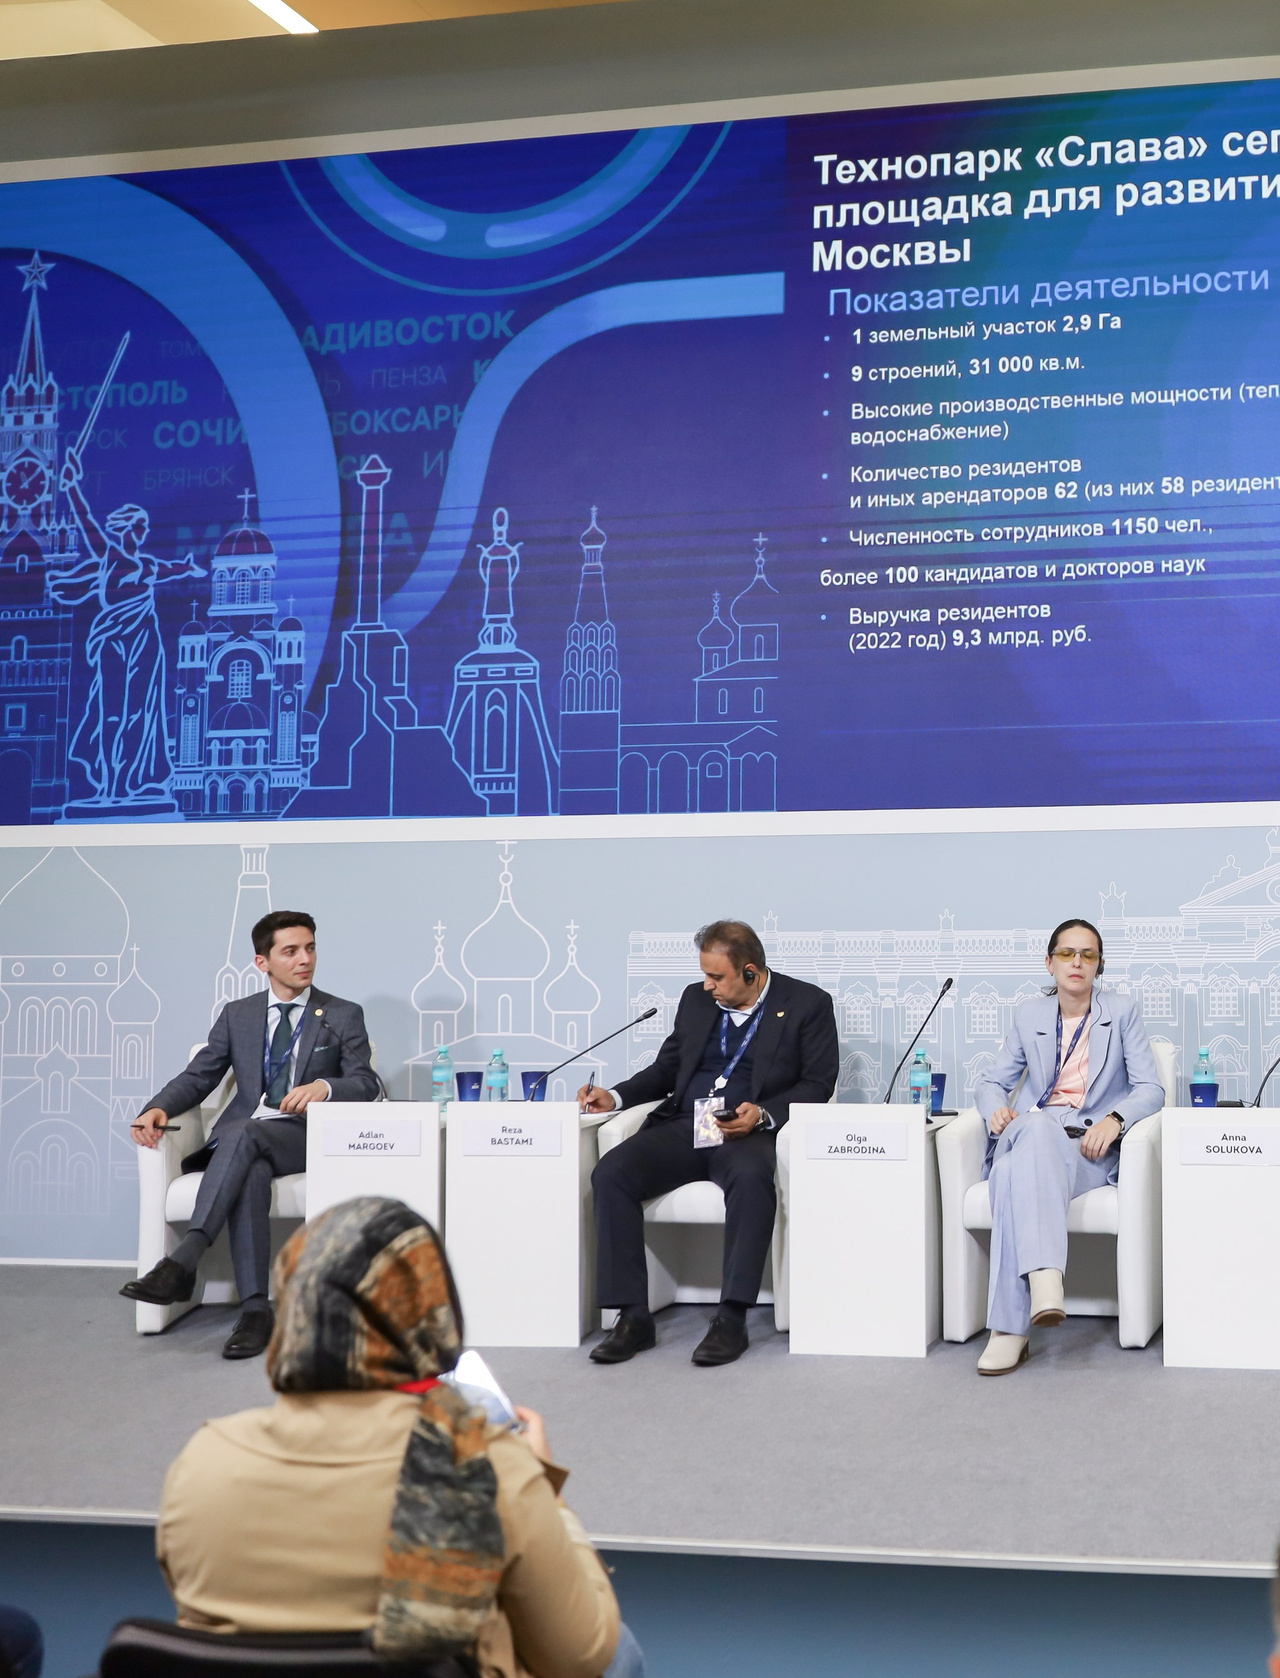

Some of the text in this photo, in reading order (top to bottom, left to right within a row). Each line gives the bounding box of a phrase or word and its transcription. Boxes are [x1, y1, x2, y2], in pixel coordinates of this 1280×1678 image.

[813, 146, 1023, 186] Технопарк
[1034, 134, 1208, 169] «Слава»
[813, 191, 1013, 229] площадка
[1023, 185, 1101, 220] для
[812, 237, 971, 273] Москвы
[829, 269, 1269, 316] Показатели деятельности
[852, 312, 1122, 345] 1 земельный участок 2,9 Га
[371, 365, 448, 389] ПЕНЗА
[851, 354, 1085, 384] 9 строений, 31 000 кв.м.
[851, 402, 934, 420] Высокие
[939, 392, 1125, 419] производственные
[1130, 386, 1232, 407] мощности
[850, 420, 1009, 448] водоснабжение)
[850, 458, 1082, 483] Количество резидентов
[850, 495, 862, 509] и
[867, 492, 916, 508] иных
[921, 486, 1048, 509] арендаторов
[1054, 480, 1079, 500] 62
[1084, 480, 1114, 502] (из
[1119, 481, 1155, 497] них
[1161, 475, 1185, 495] 58
[849, 516, 1213, 547] Численность сотрудников 1150 чел.,
[820, 557, 1206, 587] более 100 кандидатов и докторов наук
[849, 604, 1052, 628] Выручка резидентов
[848, 624, 1092, 654] (2022 год) 9,3 млрд. руб.
[358, 1131, 385, 1139] Adlan
[490, 1137, 533, 1146] BASTAMI
[501, 1125, 523, 1134] Reza
[845, 1133, 868, 1144] Olga
[1220, 1133, 1247, 1142] Anna
[348, 1142, 395, 1151] MARGOEV
[827, 1145, 886, 1155] ZABRODINA
[1205, 1144, 1263, 1155] SOLUKOVA
